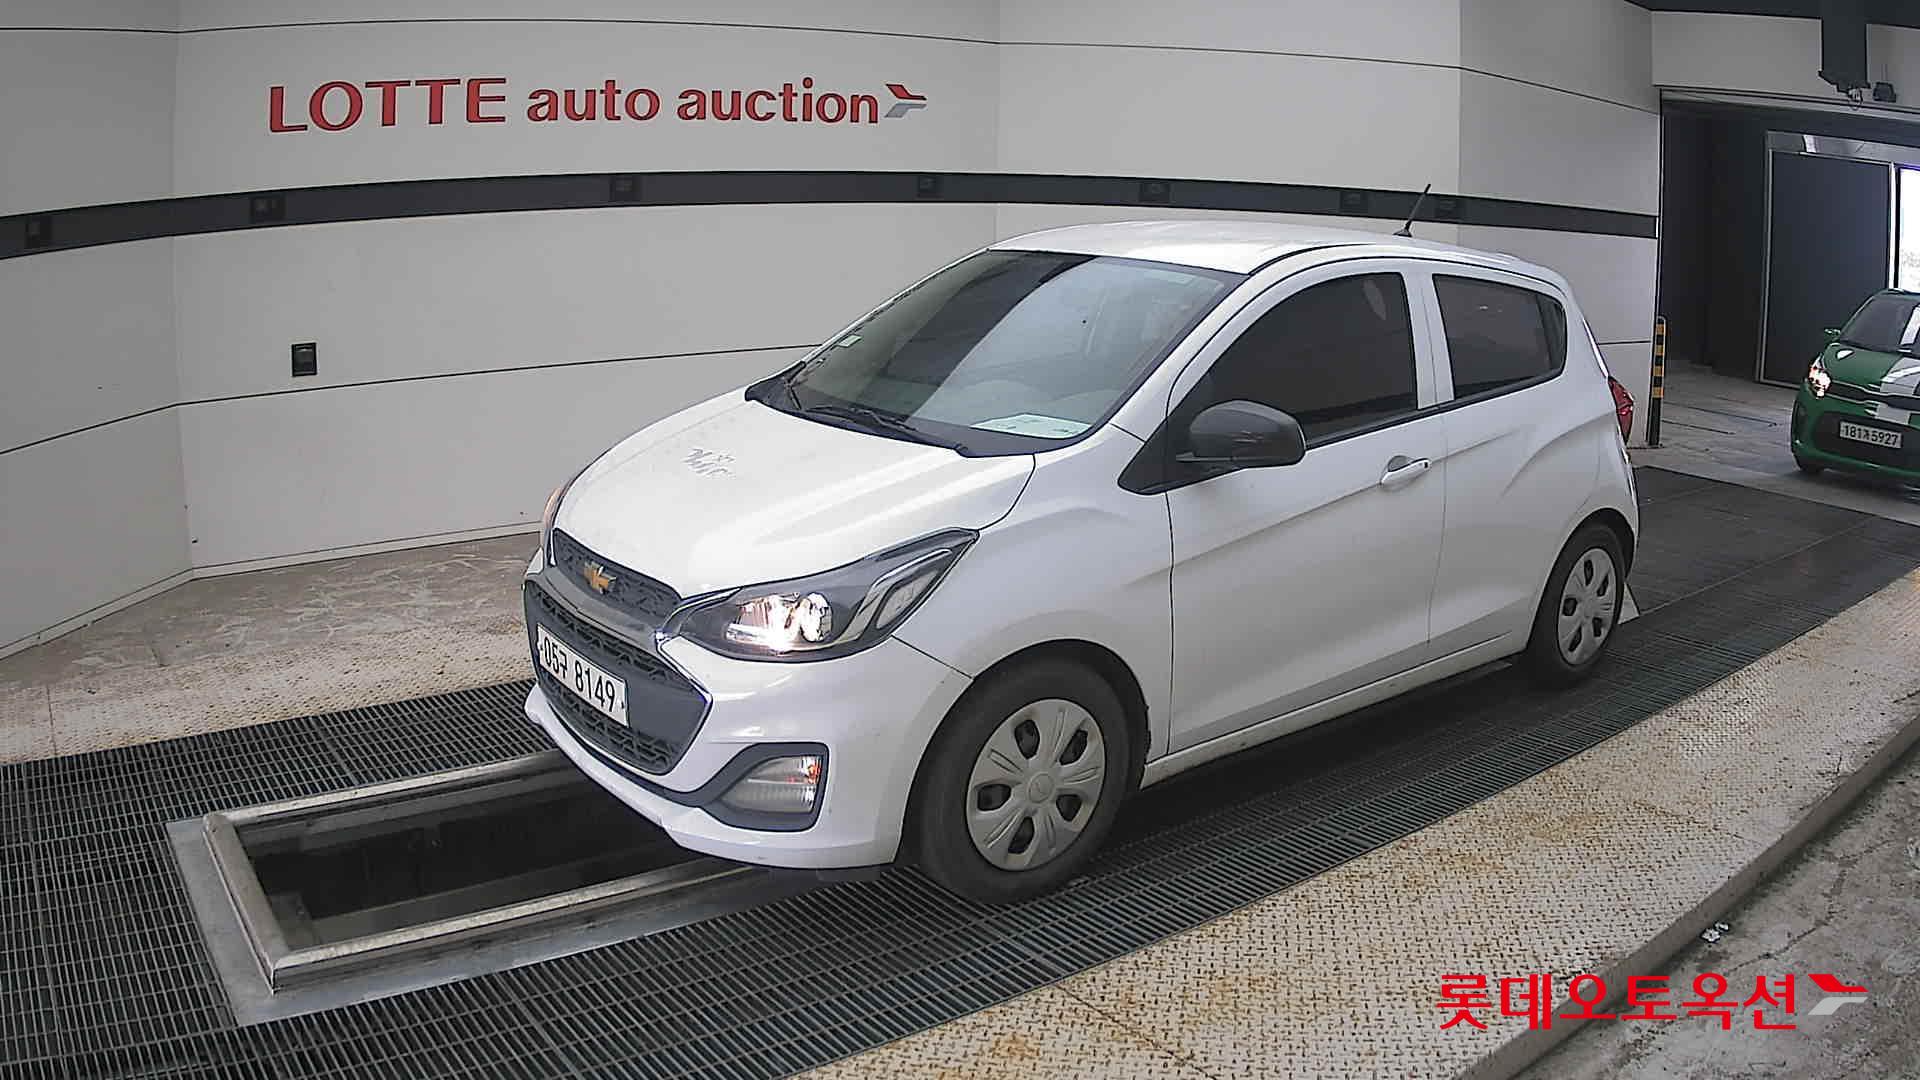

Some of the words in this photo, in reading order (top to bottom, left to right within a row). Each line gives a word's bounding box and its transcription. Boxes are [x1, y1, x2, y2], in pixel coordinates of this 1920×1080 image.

[269, 78, 507, 132] LOTTE
[527, 79, 661, 122] auto
[676, 77, 879, 124] auction
[574, 659, 616, 713] 8149
